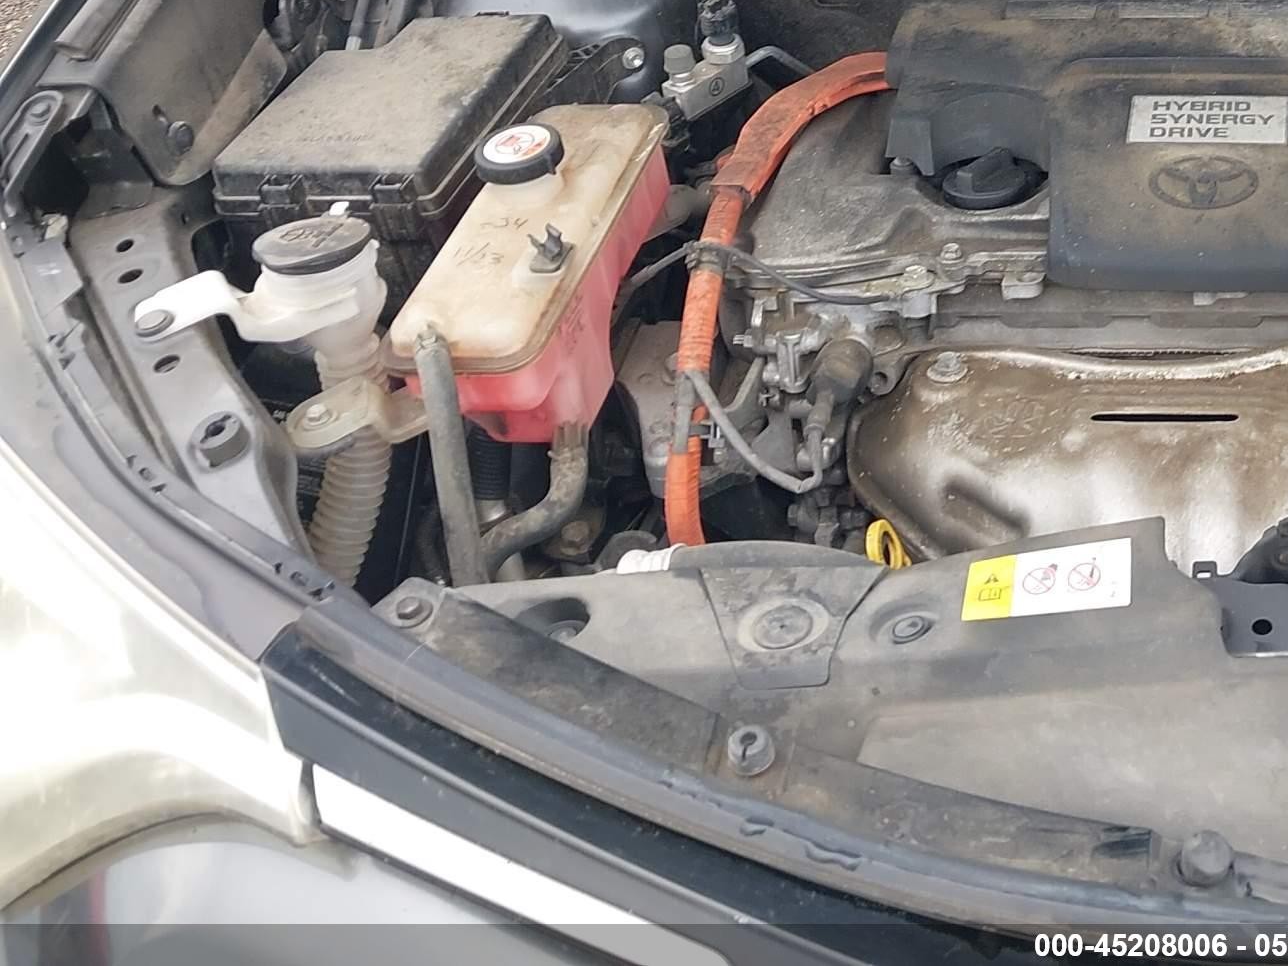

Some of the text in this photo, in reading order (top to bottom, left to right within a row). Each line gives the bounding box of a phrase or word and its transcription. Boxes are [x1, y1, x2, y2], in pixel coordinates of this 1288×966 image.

[1153, 101, 1251, 112] HYBRID
[1151, 113, 1275, 125] SYNERGY
[1150, 127, 1229, 138] DRIVE
